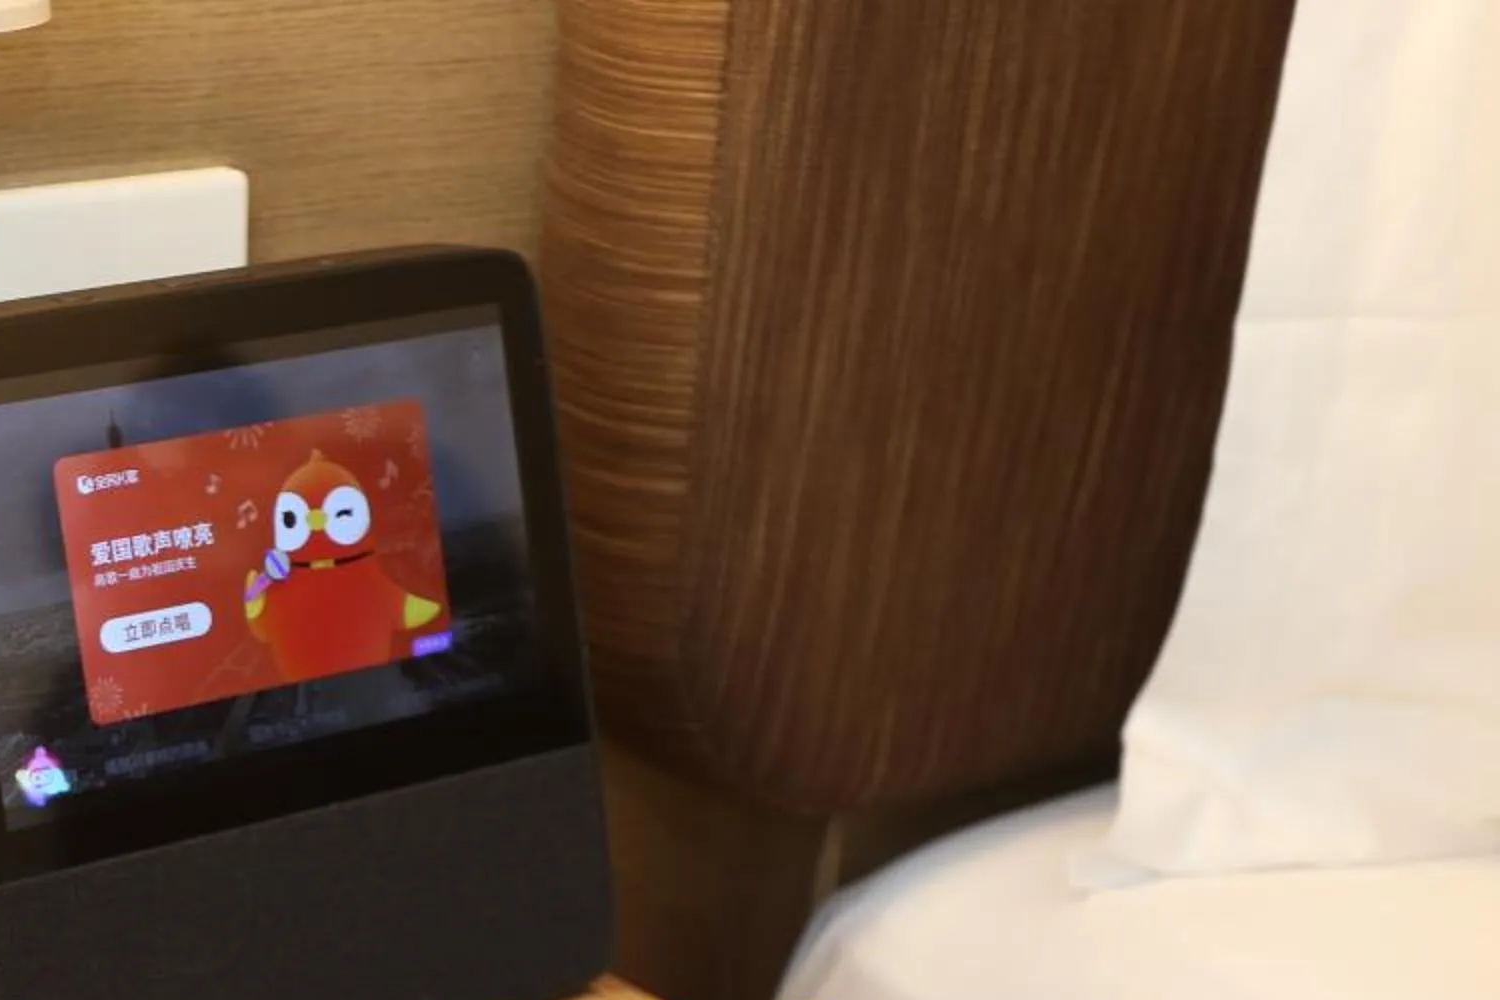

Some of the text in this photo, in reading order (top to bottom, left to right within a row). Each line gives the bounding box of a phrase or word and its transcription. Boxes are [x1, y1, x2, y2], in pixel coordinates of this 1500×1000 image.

[90, 522, 215, 567] 爱国歌声嘹亮
[124, 612, 191, 642] 立即点唱
